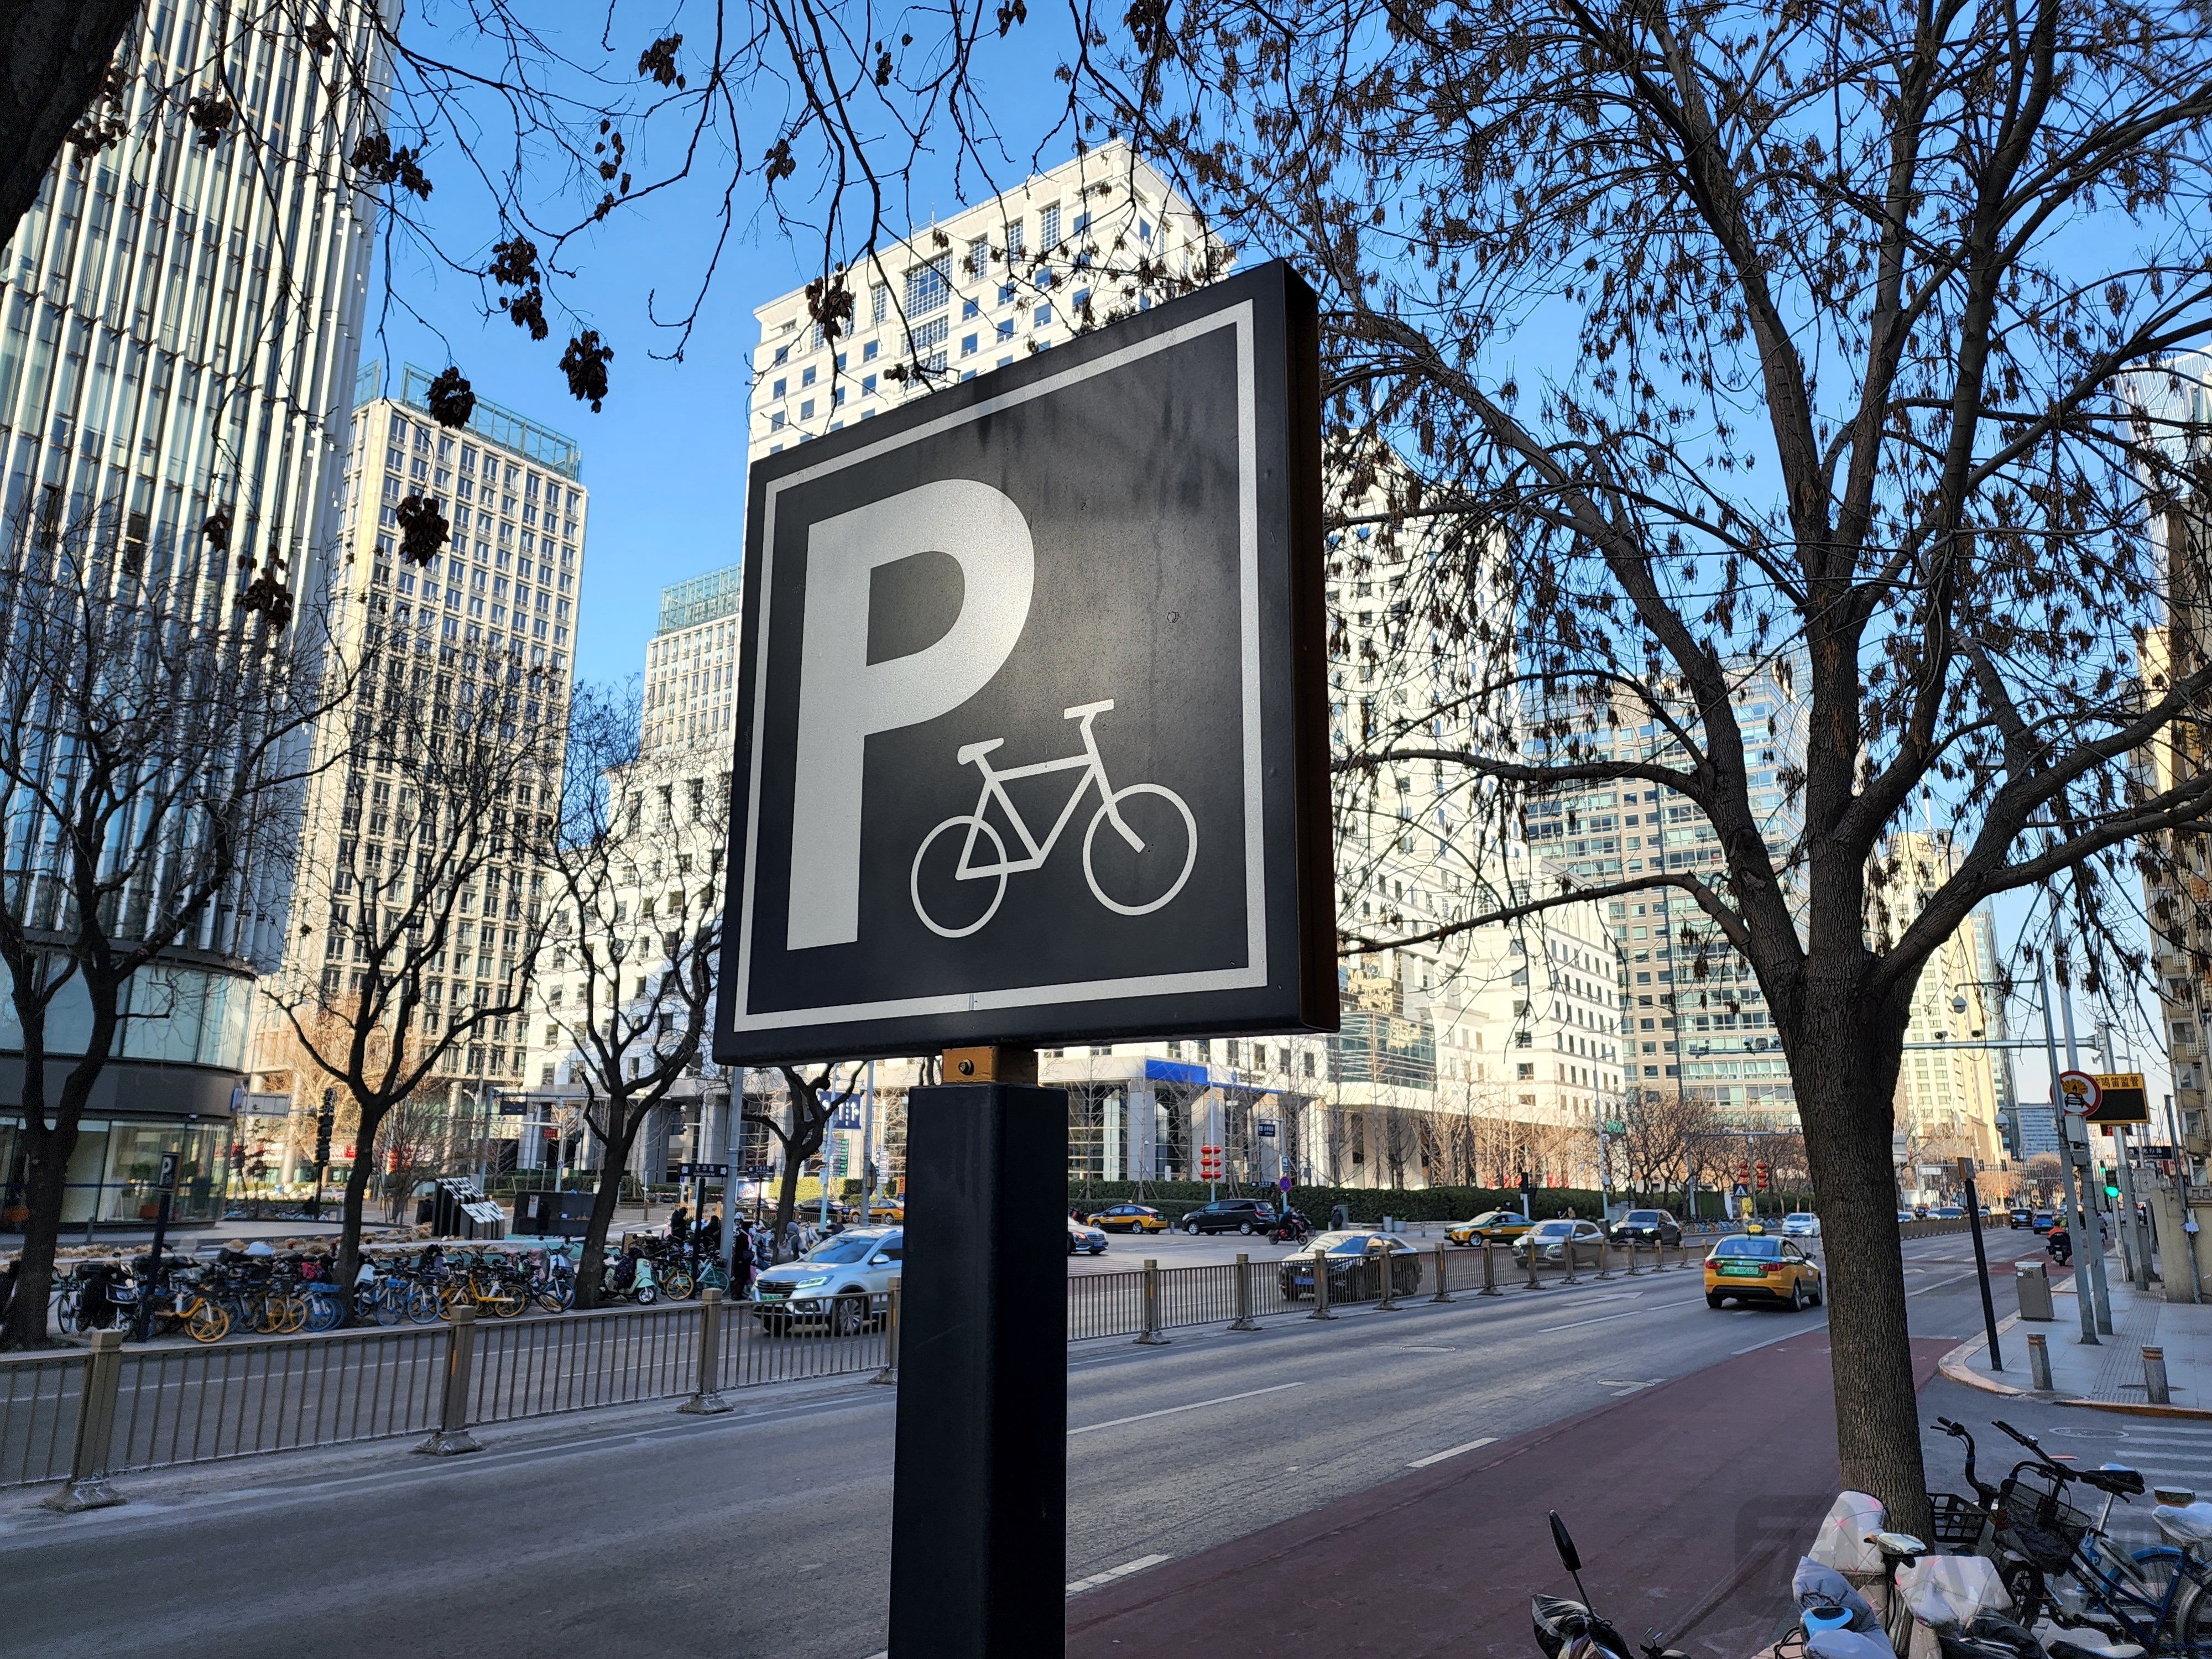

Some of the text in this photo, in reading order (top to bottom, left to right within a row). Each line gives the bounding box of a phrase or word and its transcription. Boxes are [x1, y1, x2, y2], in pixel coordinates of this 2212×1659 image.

[787, 478, 1035, 951] P
[159, 1157, 171, 1186] P
[436, 1177, 484, 1199] 光华路
